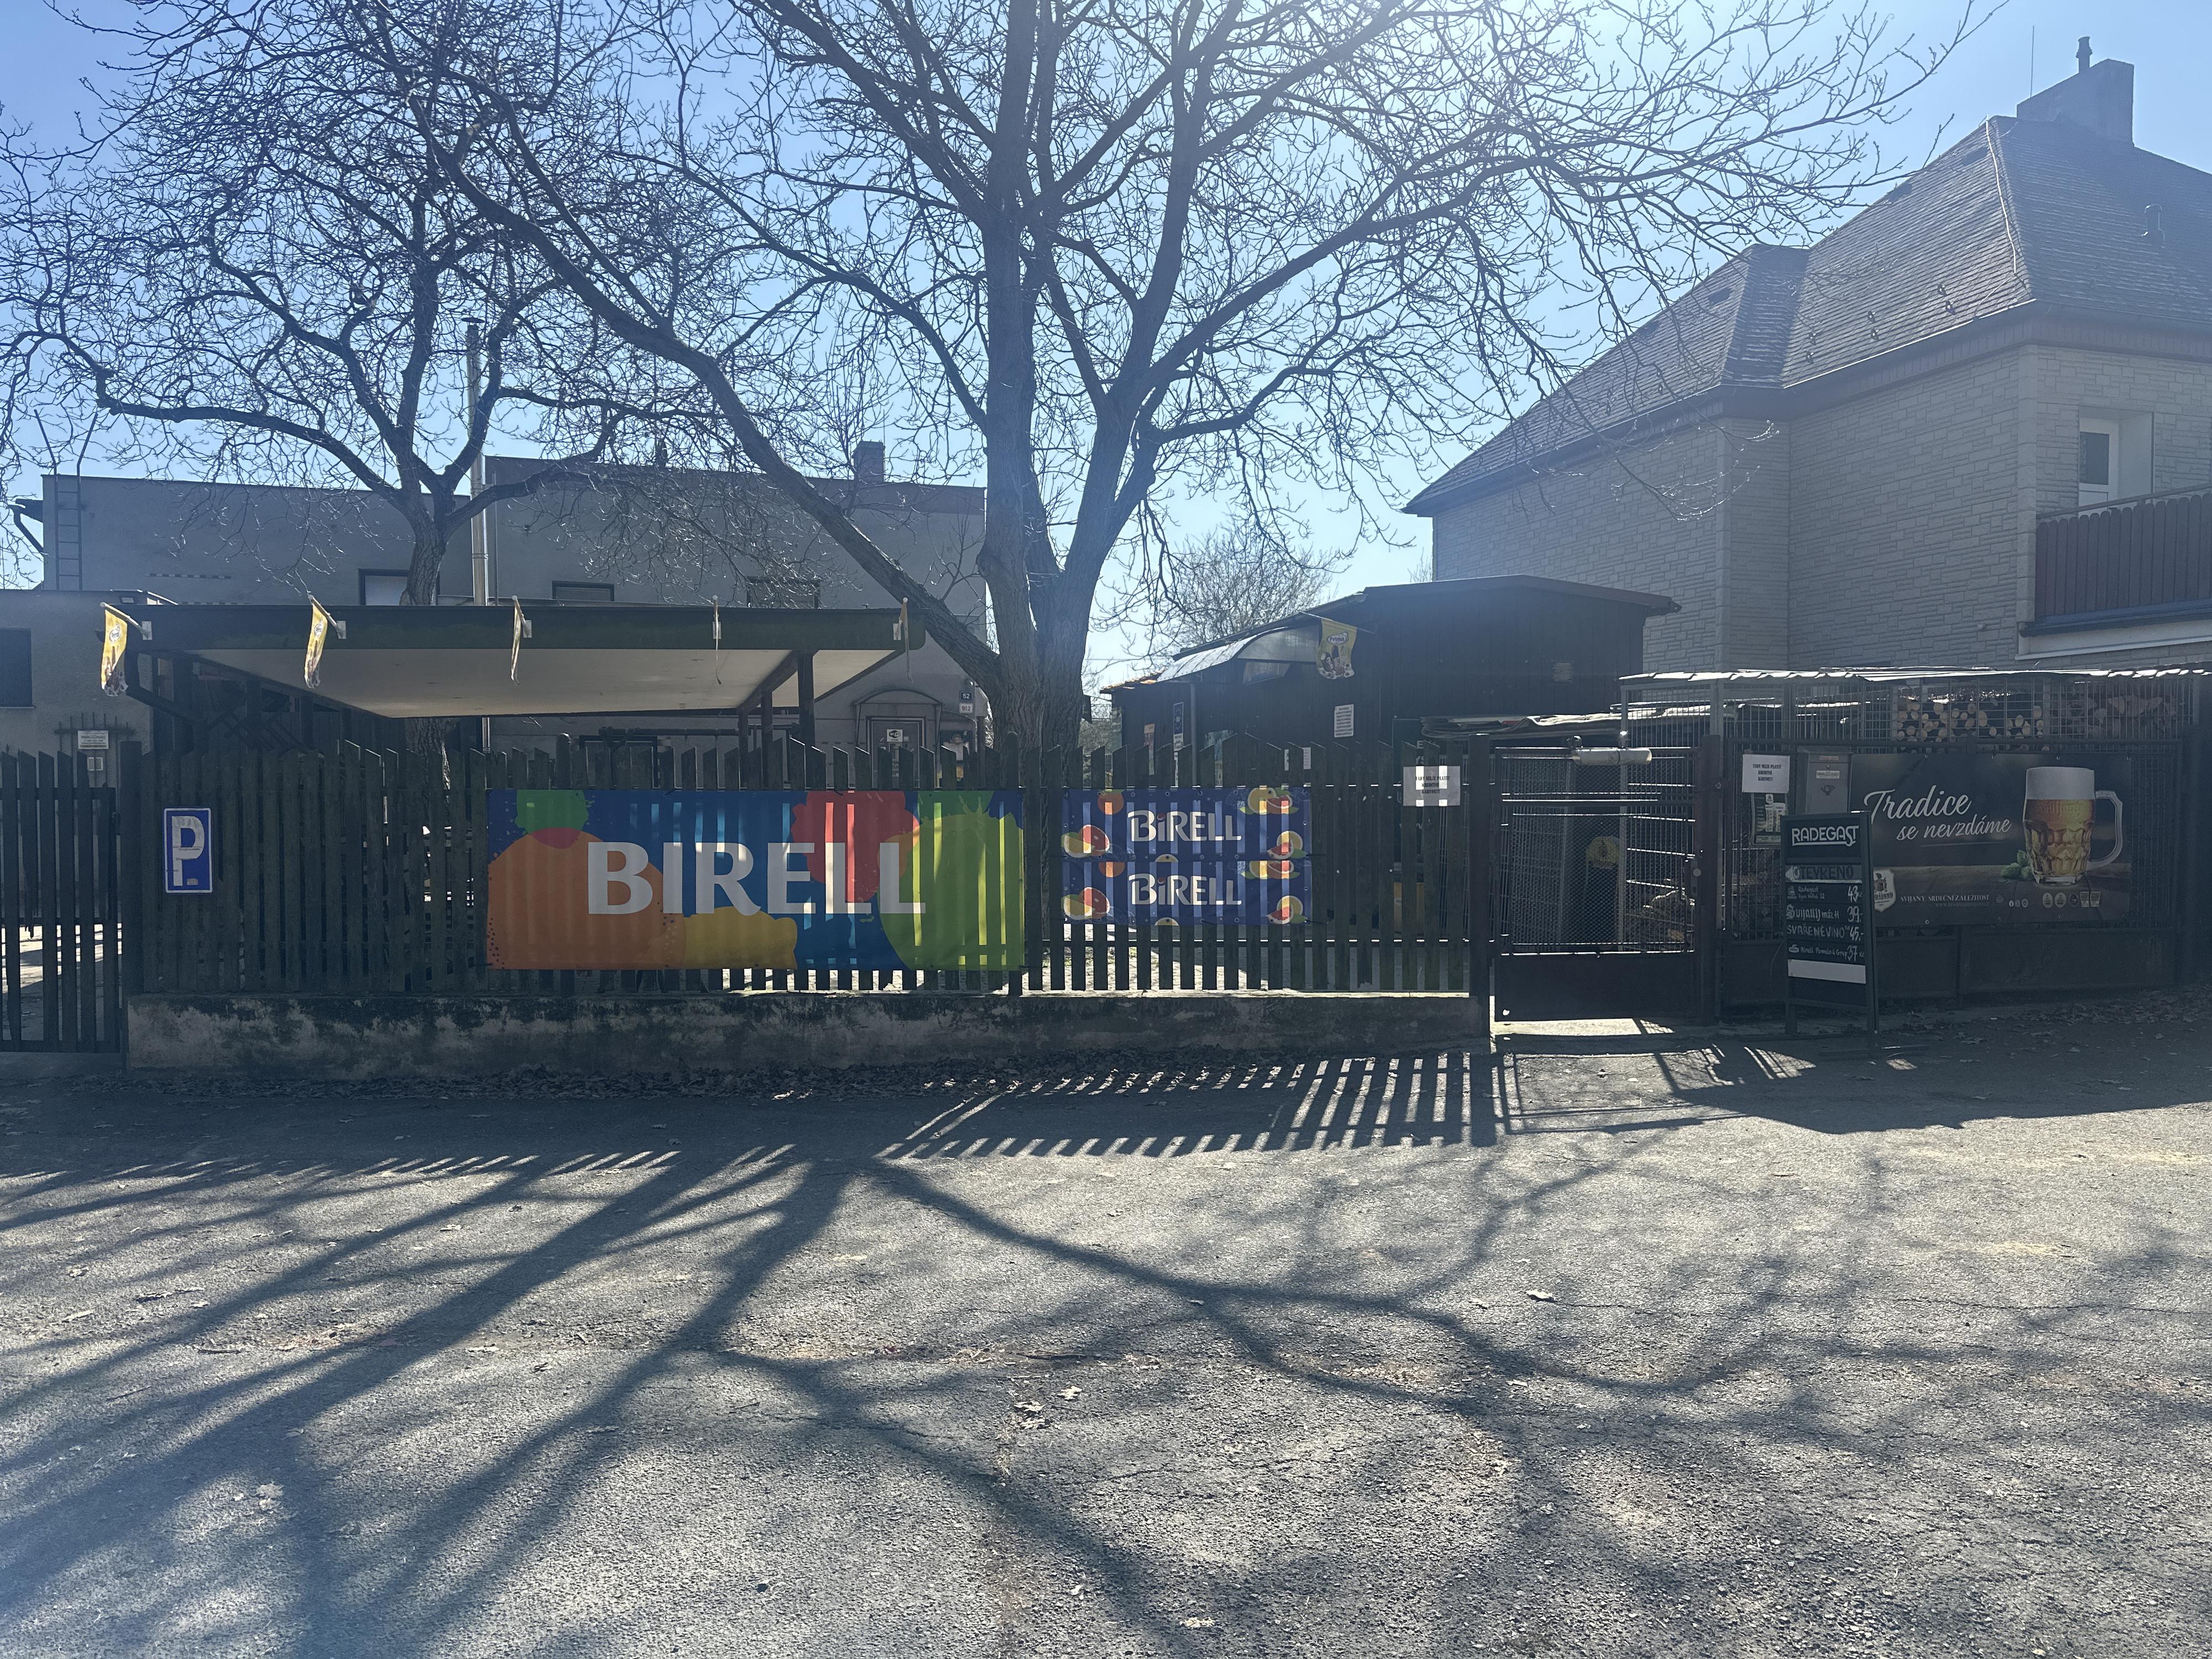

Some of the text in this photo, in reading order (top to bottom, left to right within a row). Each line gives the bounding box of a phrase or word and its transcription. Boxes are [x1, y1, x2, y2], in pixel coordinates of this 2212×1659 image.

[1864, 785, 1972, 825] Tradice
[1791, 825, 1859, 847] RADEGAST
[1896, 813, 2012, 841] se nevzdáme
[171, 816, 205, 886] P
[587, 842, 926, 915] BIRELL
[1848, 885, 1858, 902] 43
[1847, 945, 1858, 962] 37
